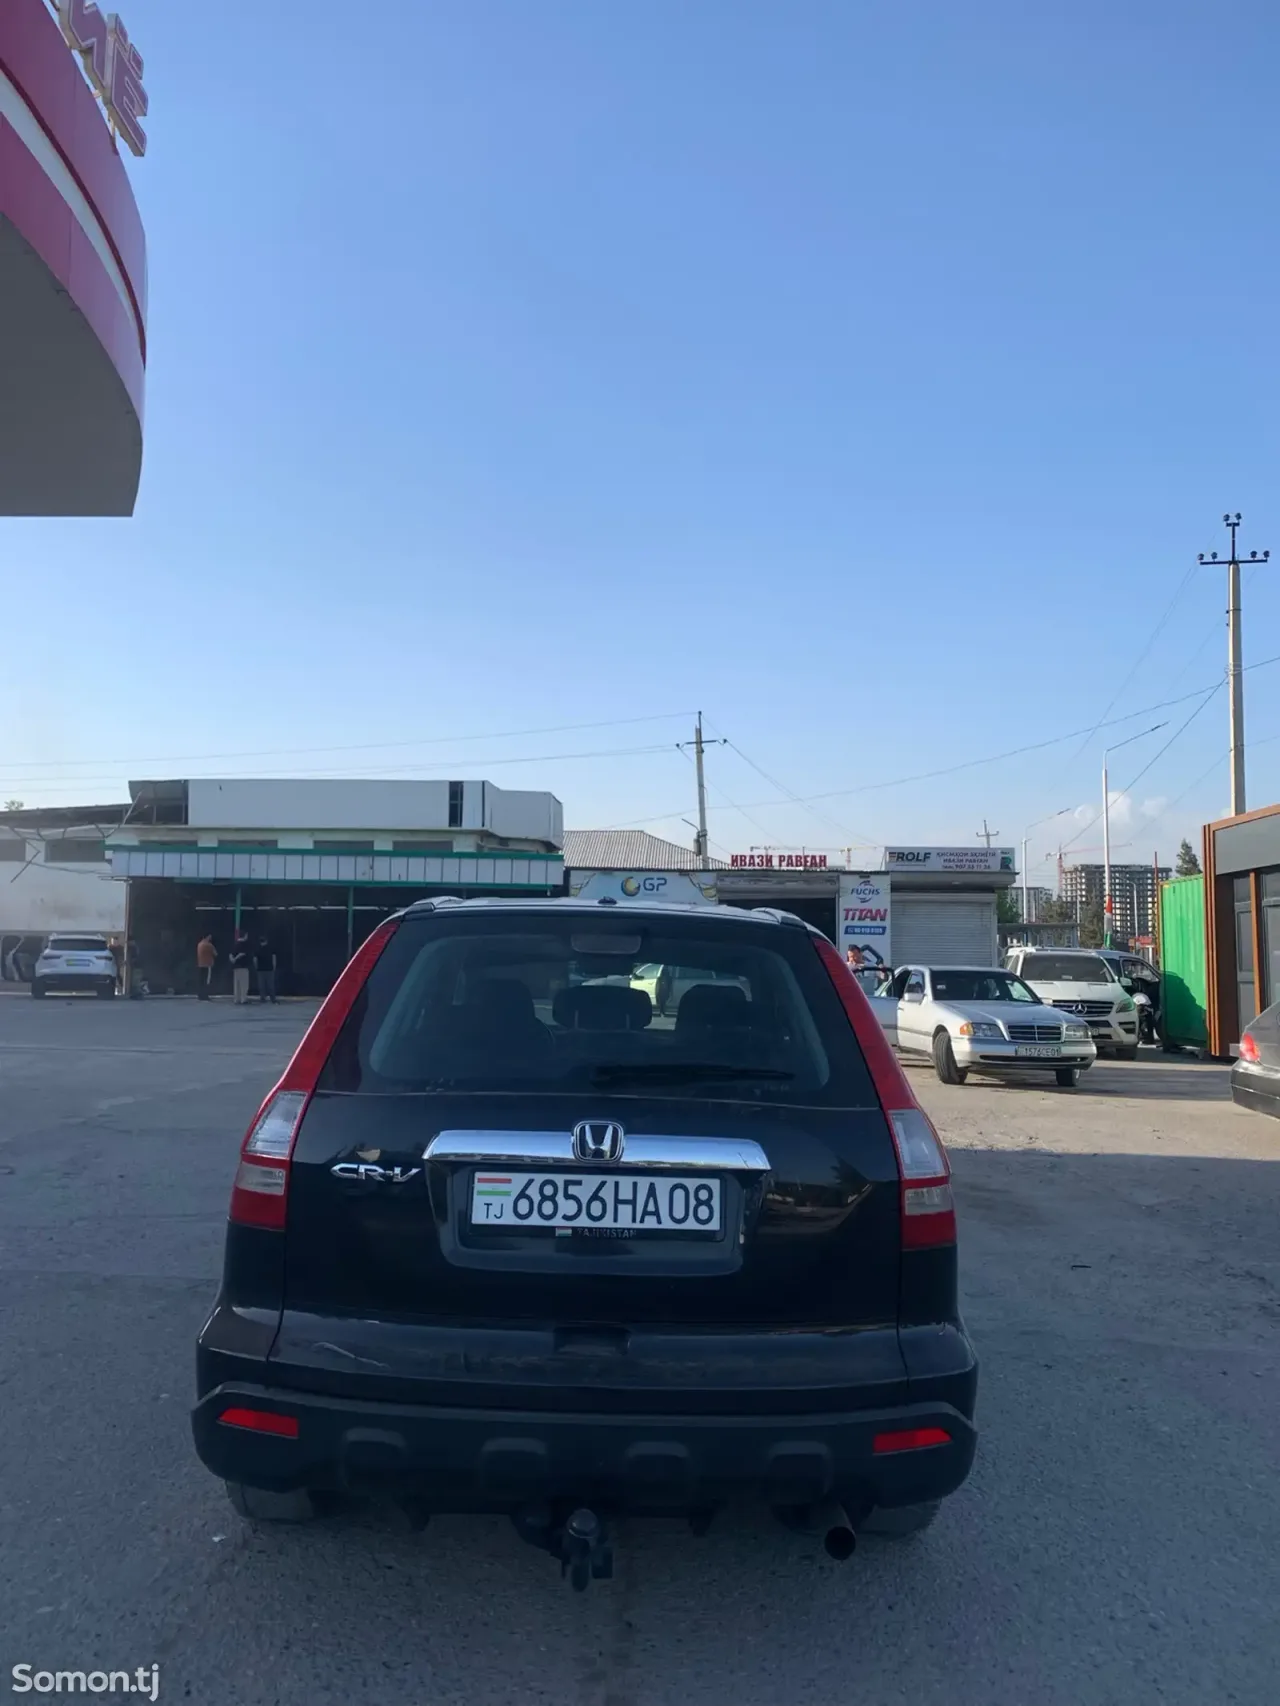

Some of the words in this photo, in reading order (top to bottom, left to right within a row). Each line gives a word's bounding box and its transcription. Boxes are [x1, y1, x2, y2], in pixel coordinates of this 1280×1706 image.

[731, 854, 773, 868] ИВАЗИ
[895, 852, 931, 862] ROLF
[643, 877, 668, 892] GP
[850, 887, 880, 896] FUCHS
[843, 907, 888, 922] TITAN
[330, 1163, 422, 1182] CR-V
[483, 1202, 504, 1220] TJ
[512, 1178, 714, 1226] 6856HA08
